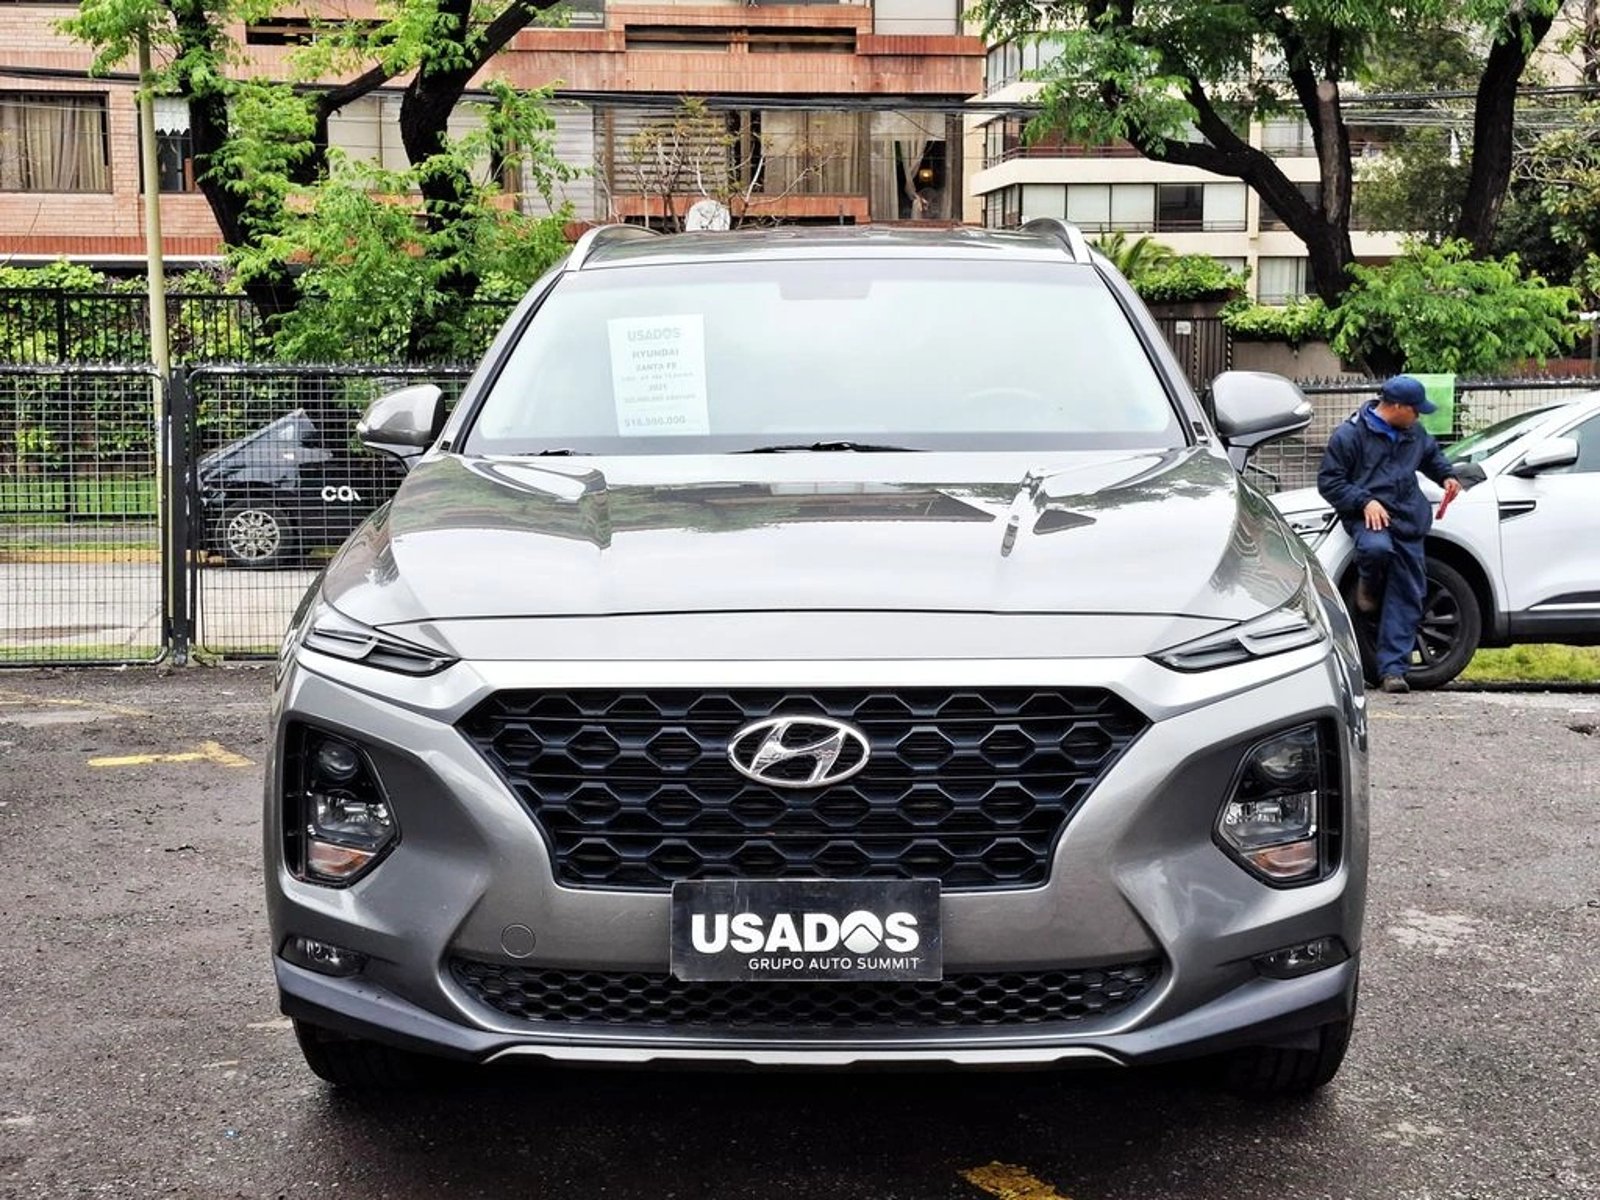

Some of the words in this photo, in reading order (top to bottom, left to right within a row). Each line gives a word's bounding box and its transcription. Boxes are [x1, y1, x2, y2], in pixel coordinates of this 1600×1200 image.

[627, 327, 681, 341] USADOS
[632, 348, 679, 359] HYUNDAI
[691, 910, 920, 954] USADOS
[748, 957, 804, 970] GRUPO
[808, 957, 853, 970] AUTO
[857, 957, 920, 970] SUMMIT
